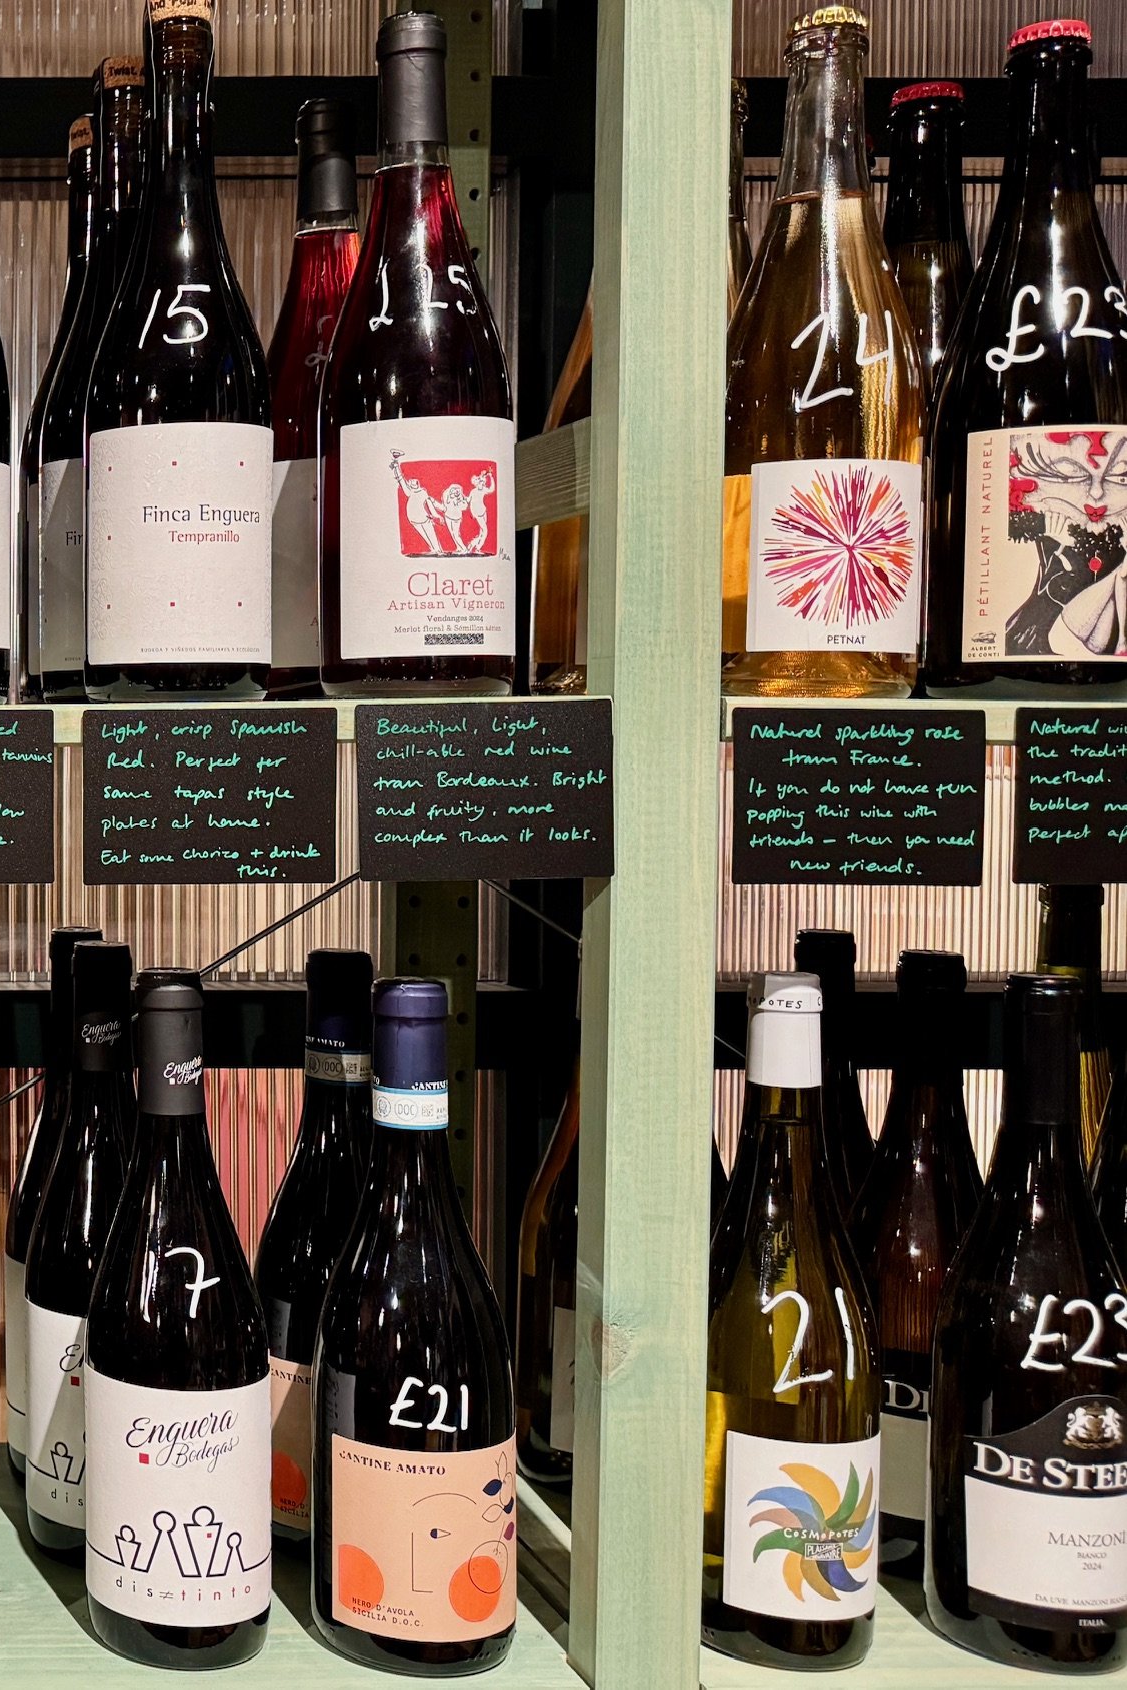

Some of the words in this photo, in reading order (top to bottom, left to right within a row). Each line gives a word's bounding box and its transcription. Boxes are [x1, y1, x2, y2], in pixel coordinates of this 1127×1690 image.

[138, 283, 211, 349] 15
[790, 309, 894, 413] 24
[982, 437, 993, 514] NATUREL
[143, 504, 191, 523] Finca
[200, 503, 260, 526] Enguera
[168, 530, 240, 545] Tempranillo
[979, 525, 991, 616] PÉTILLANT
[408, 573, 494, 596] Claret
[387, 600, 445, 610] Artisan
[452, 598, 505, 611] Vigneron
[427, 615, 467, 623] Vendanges
[827, 635, 866, 645] PETNAT
[171, 721, 213, 740] crisp
[231, 719, 307, 739] Spanish
[835, 723, 915, 746] sparkling
[1031, 718, 1100, 735] Natural
[2, 748, 53, 764] tannins
[484, 741, 515, 757] red
[552, 769, 607, 790] Bright
[820, 779, 840, 794] do
[174, 785, 225, 805] tapas
[247, 786, 294, 809] style
[1029, 797, 1089, 812] bubbles
[376, 802, 416, 816] and
[508, 803, 554, 814] more
[747, 805, 805, 830] popping
[101, 814, 158, 837] plates
[374, 829, 448, 848] complex
[459, 830, 509, 843] than
[937, 830, 975, 846] need
[101, 849, 132, 865] Eat
[270, 843, 321, 859] drink
[140, 1246, 221, 1323] 17
[761, 1287, 853, 1393] 21
[389, 1376, 469, 1433] £21
[125, 1409, 239, 1467] Enguera
[175, 1435, 240, 1473] Bodegas
[339, 1451, 391, 1471] CANTINE
[396, 1463, 446, 1476] AMATO
[973, 1441, 1034, 1485] DE
[1083, 1562, 1102, 1570] 2024
[351, 1596, 372, 1609] NERO
[375, 1605, 415, 1617] D'AVOLA
[351, 1606, 387, 1622] SICILIA
[1078, 1619, 1107, 1627] ITALIA
